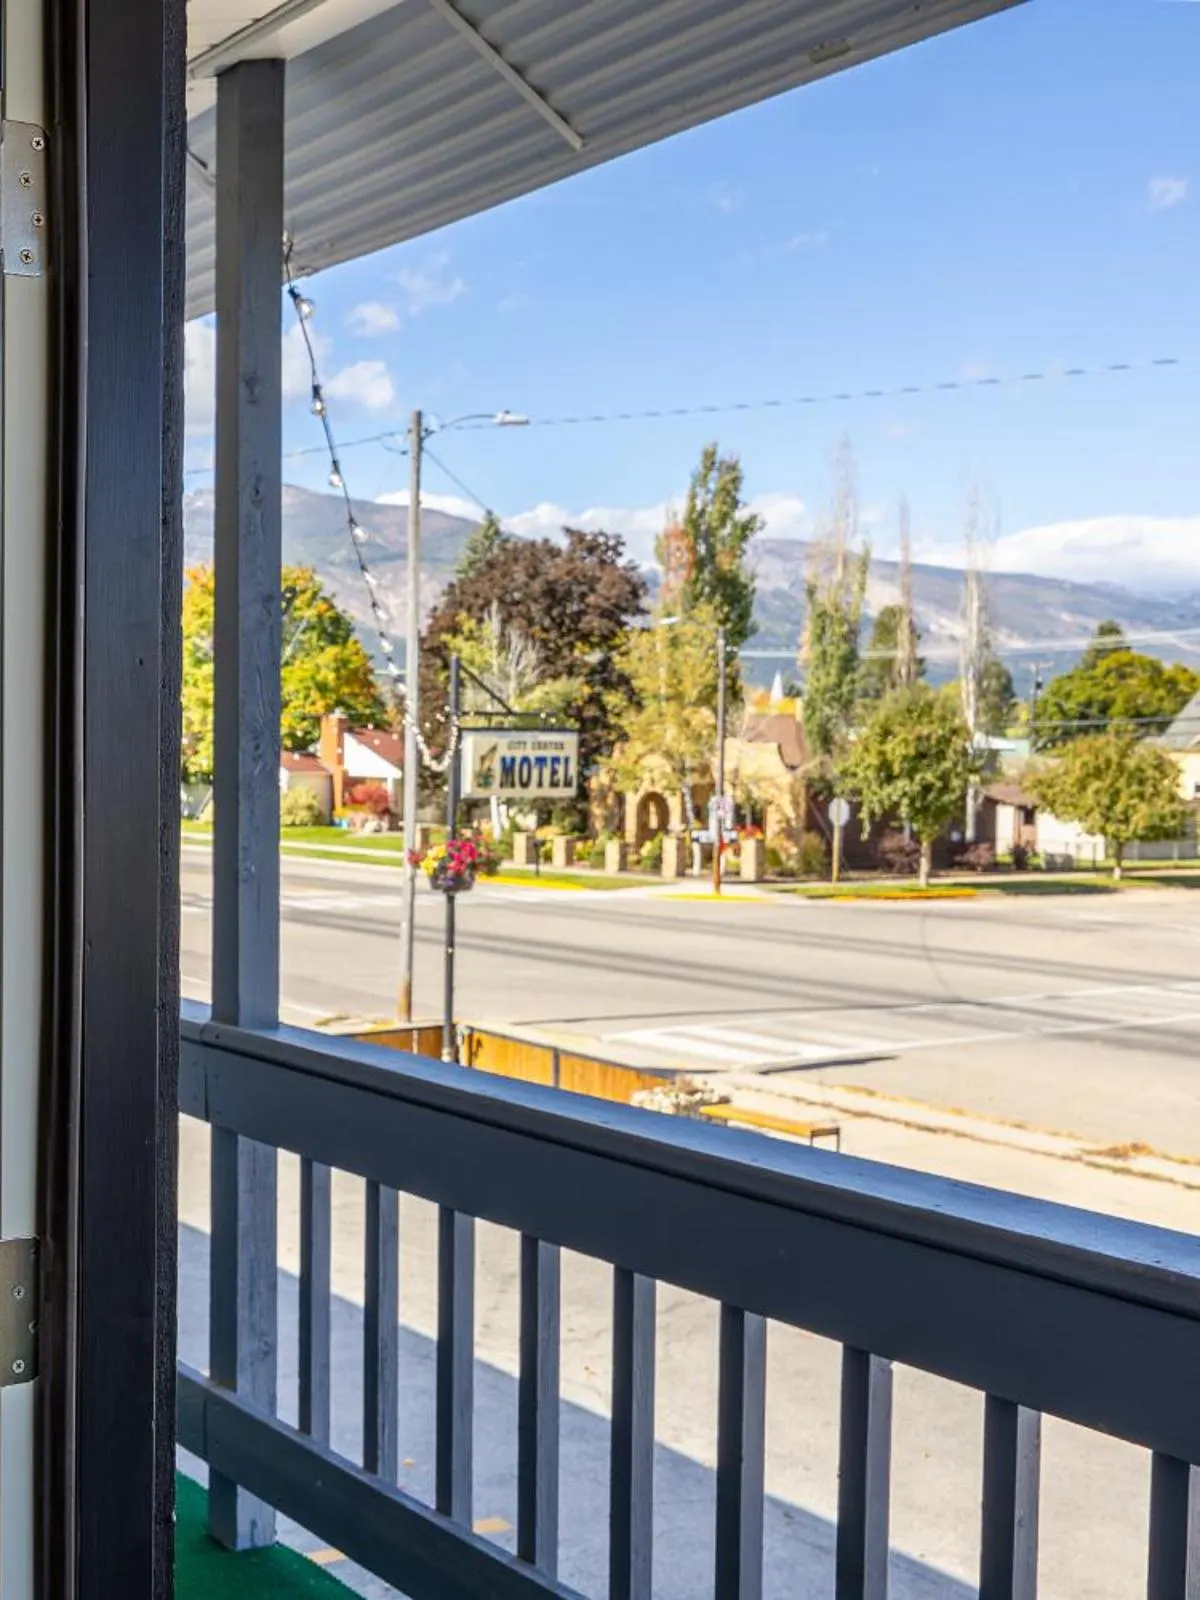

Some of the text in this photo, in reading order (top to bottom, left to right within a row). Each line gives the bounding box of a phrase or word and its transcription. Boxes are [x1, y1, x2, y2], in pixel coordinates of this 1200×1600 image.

[507, 740, 565, 751] CITY CENTER
[499, 755, 574, 789] MOTEL
